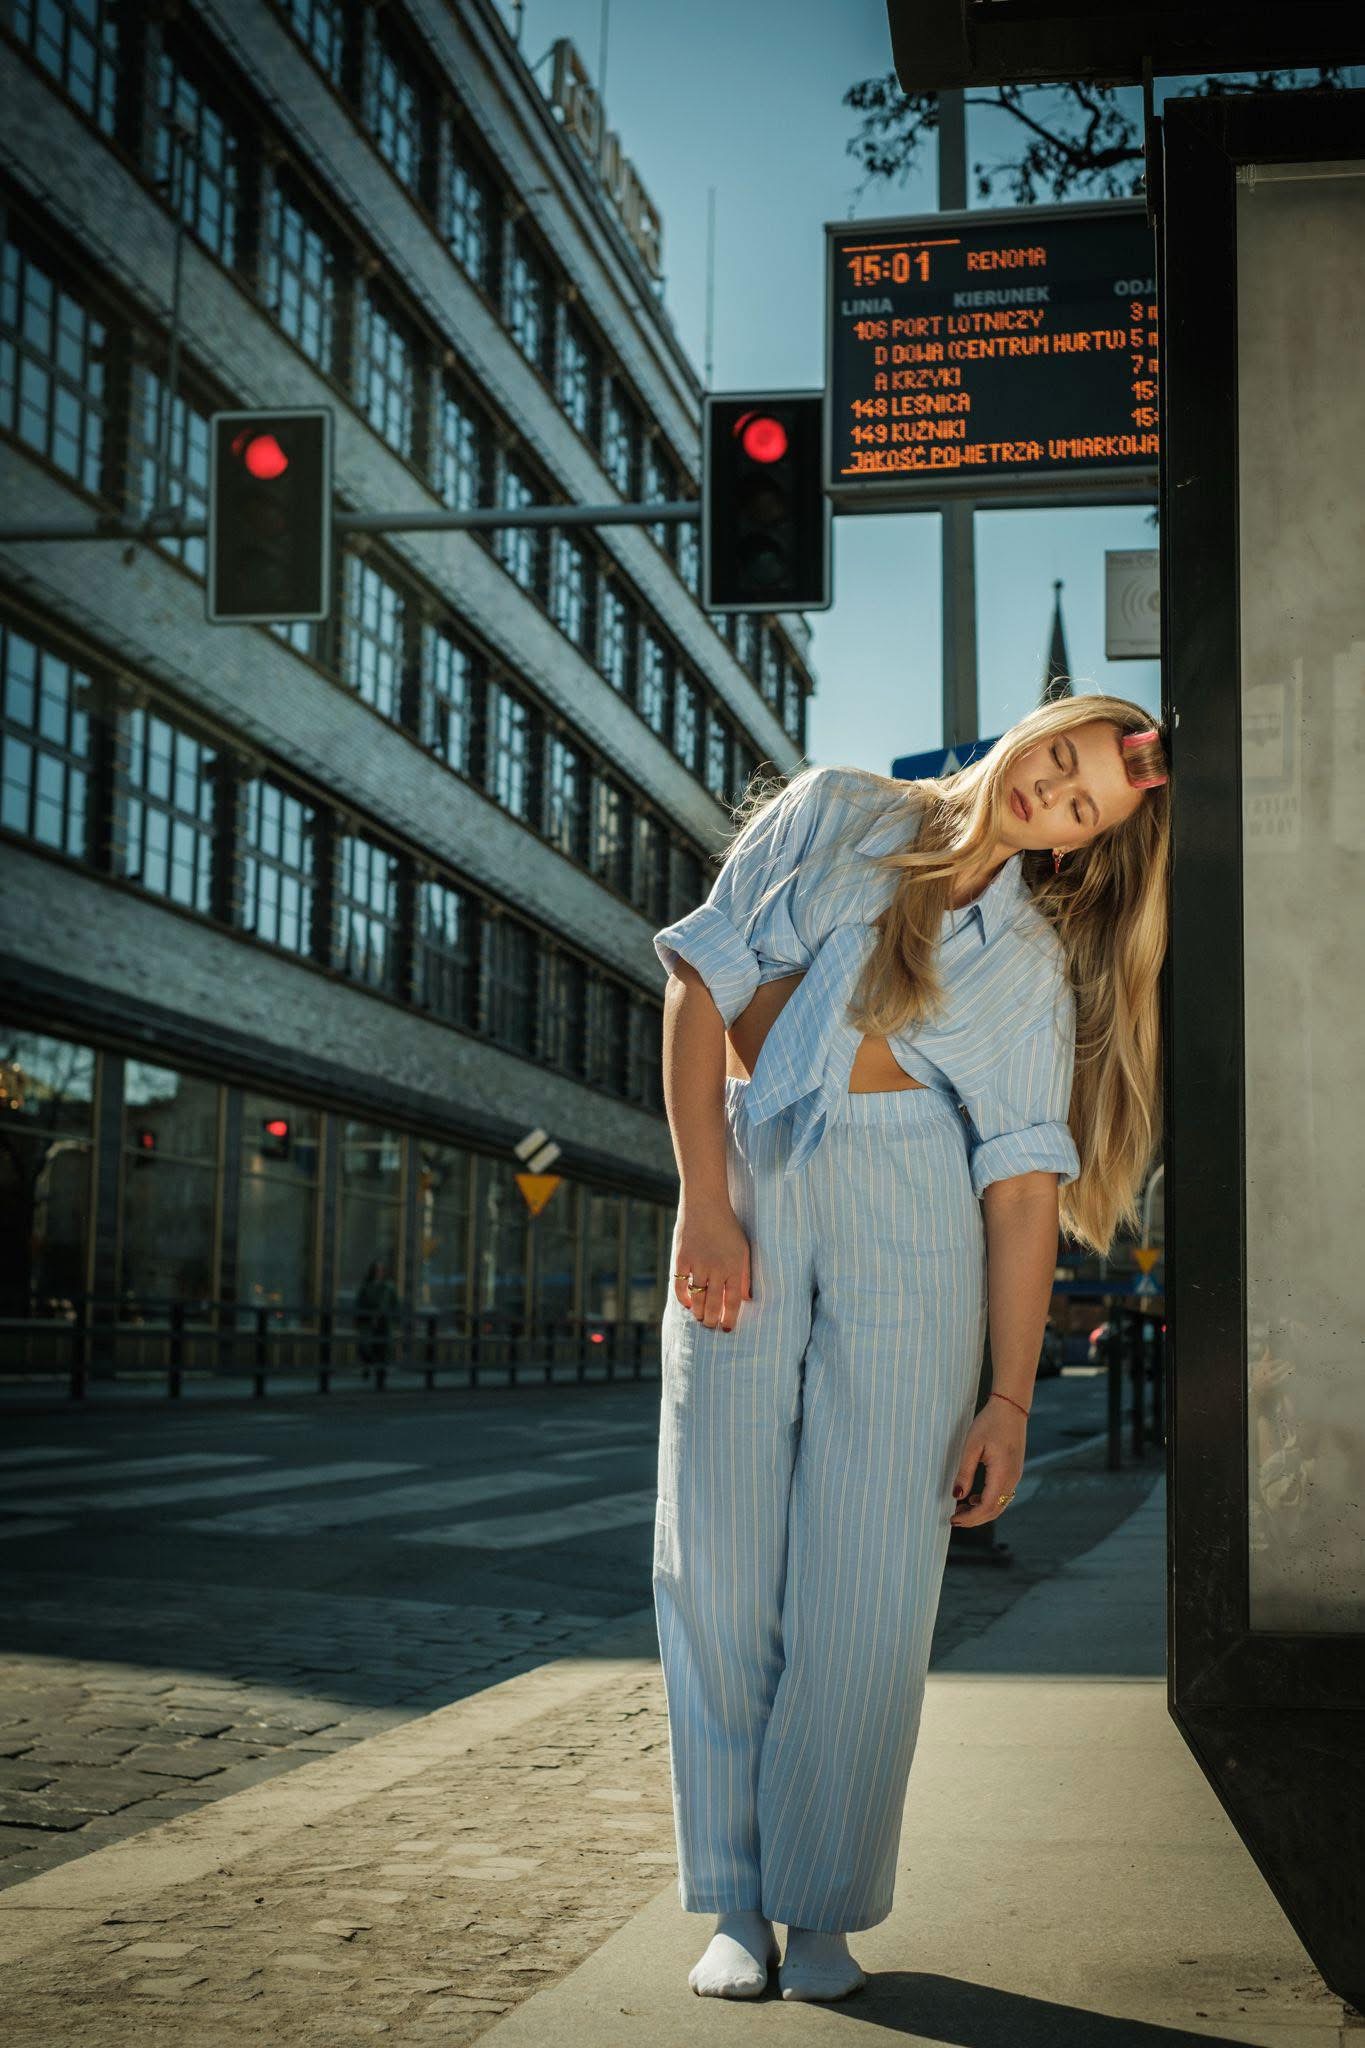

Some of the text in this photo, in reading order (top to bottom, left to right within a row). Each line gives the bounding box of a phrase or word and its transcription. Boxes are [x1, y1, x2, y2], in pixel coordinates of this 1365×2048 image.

[847, 247, 1046, 287] 15:01 RENOMA
[841, 298, 893, 316] LINIA
[953, 286, 1050, 308] KIERUNEK
[853, 320, 888, 340] 106
[892, 316, 943, 338] PORT
[947, 308, 1044, 335] LOTNICZY
[874, 346, 888, 365] D
[1130, 327, 1144, 348] 5
[874, 371, 888, 391] A
[892, 367, 961, 390] KRZYKI
[1131, 354, 1144, 375] 7
[851, 397, 888, 419] 148
[851, 423, 888, 445] 149
